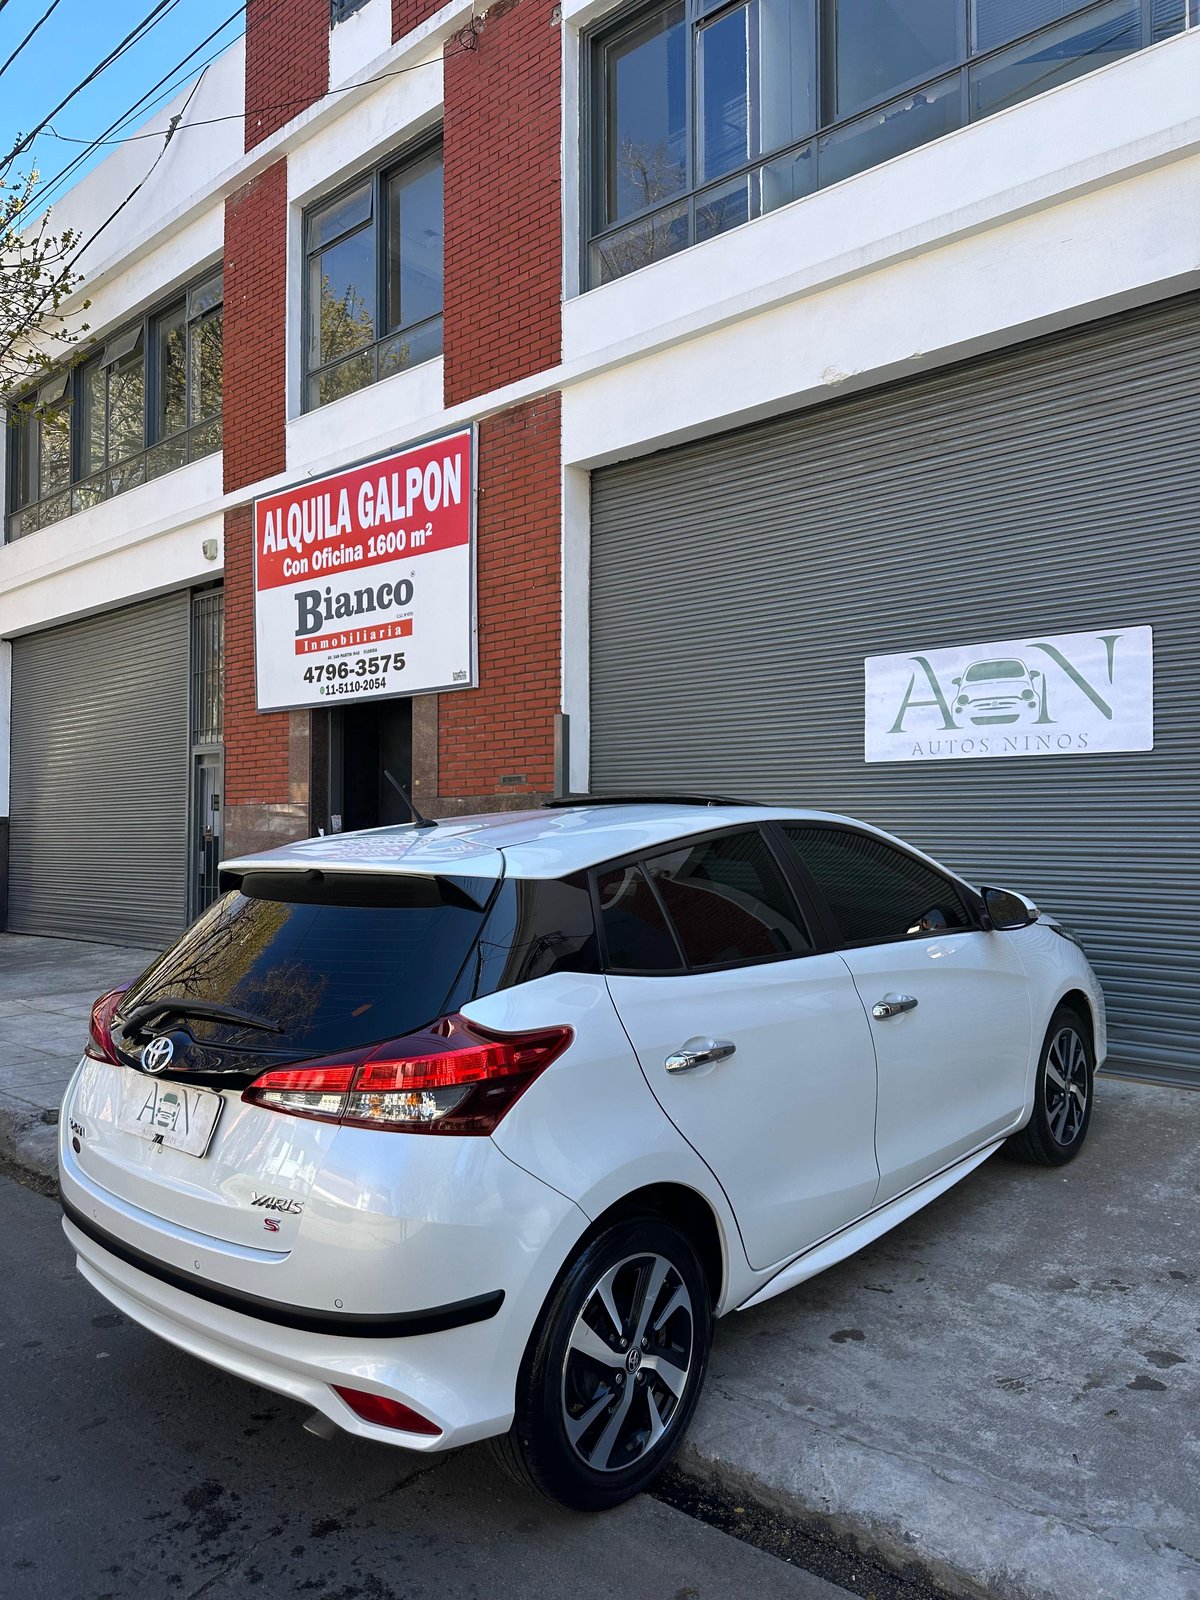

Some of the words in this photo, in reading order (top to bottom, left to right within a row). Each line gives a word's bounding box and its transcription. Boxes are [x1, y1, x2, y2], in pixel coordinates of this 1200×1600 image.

[262, 488, 352, 555] ALQUILA
[357, 453, 462, 530] GALPON
[283, 557, 309, 577] Con
[312, 543, 364, 571] Oficina
[367, 531, 406, 558] 1600
[294, 578, 414, 637] Bianco
[303, 625, 402, 652] Inmobiliaria
[303, 652, 406, 684] 4796-3575
[325, 677, 387, 695] 11-5110-2054
[911, 737, 990, 756] AUTOS
[1003, 732, 1090, 752] NINOS
[250, 1190, 304, 1215] YARIS
[263, 1217, 281, 1232] S
